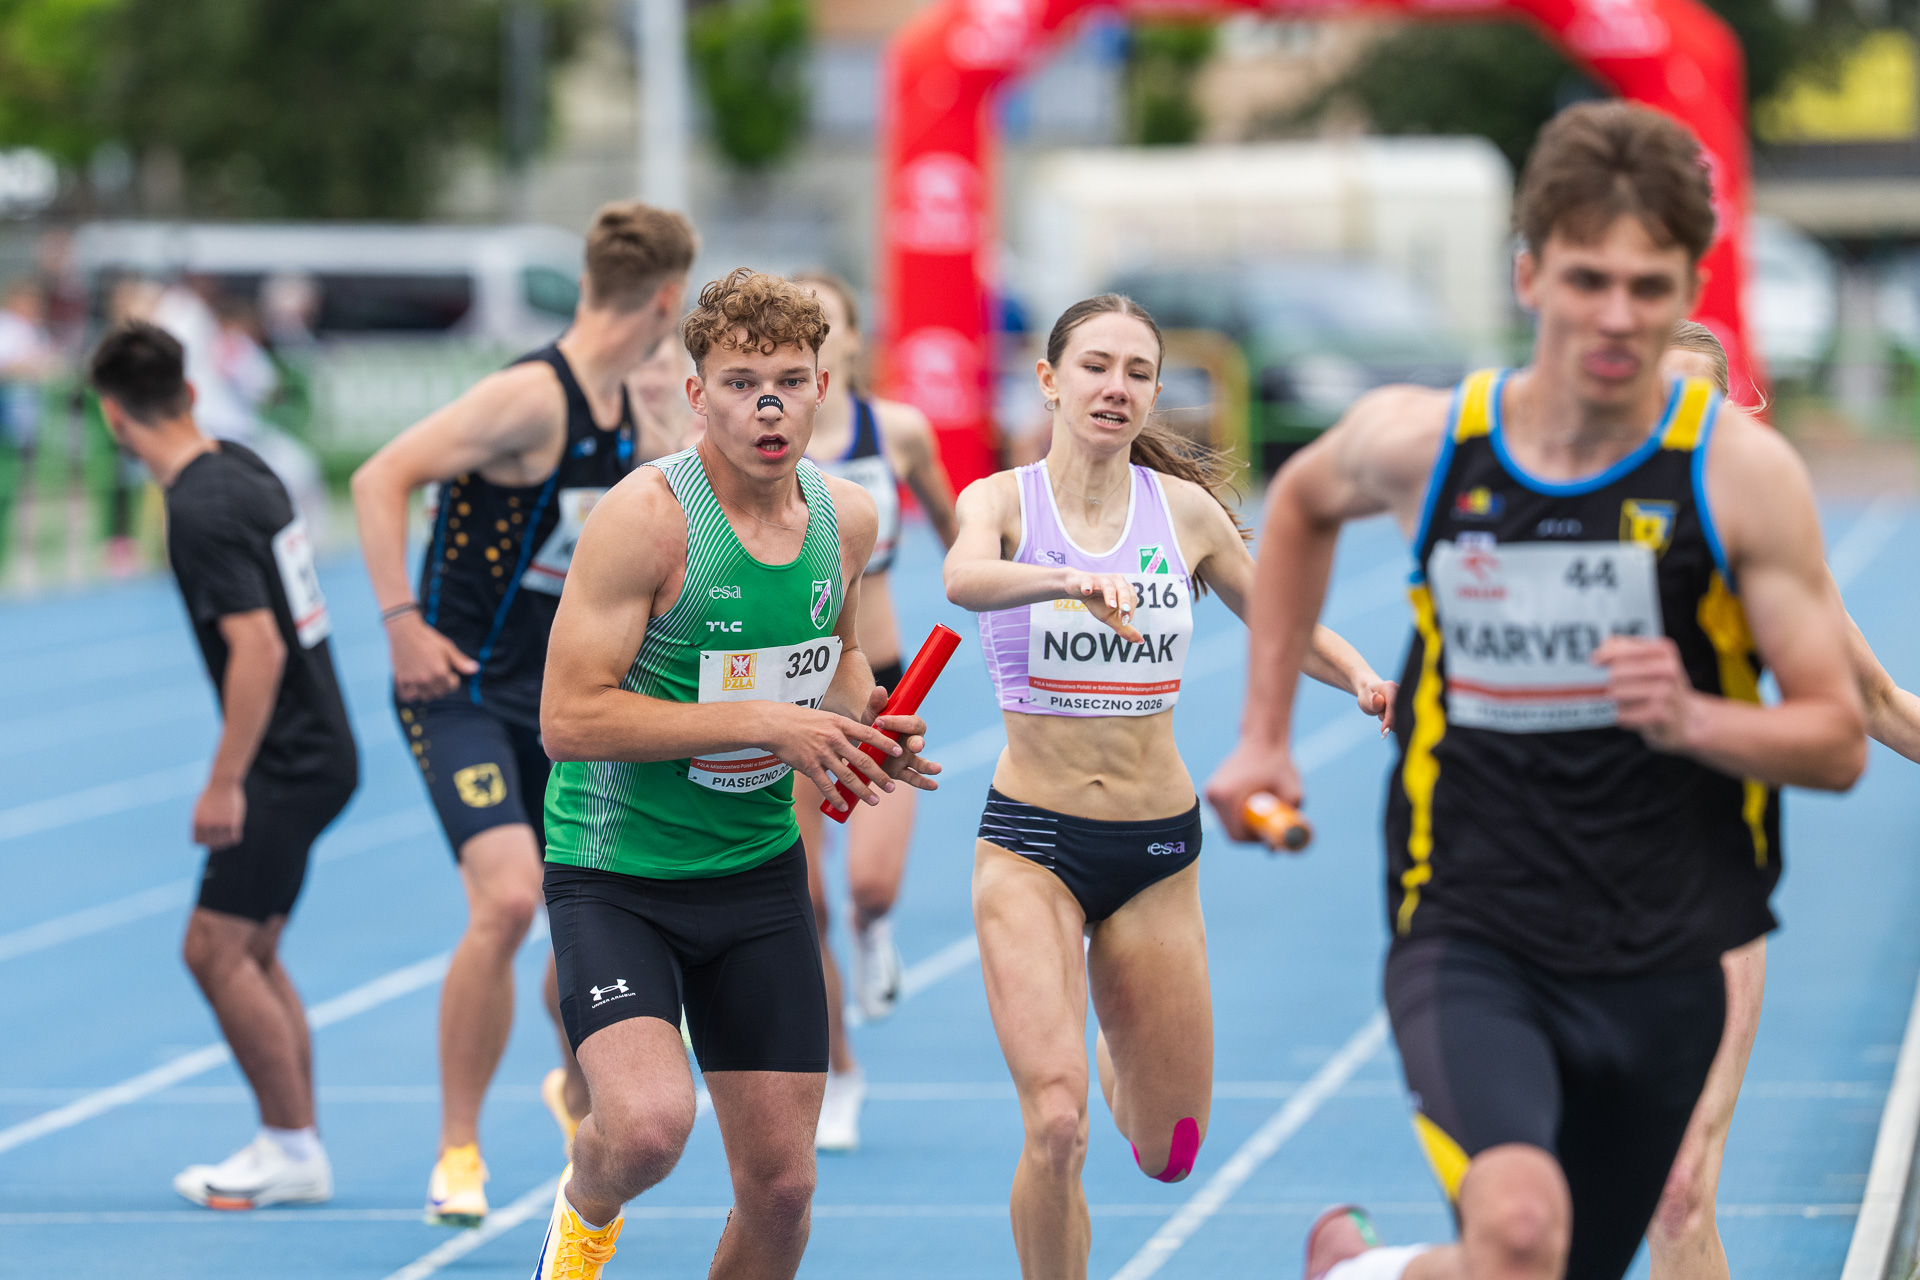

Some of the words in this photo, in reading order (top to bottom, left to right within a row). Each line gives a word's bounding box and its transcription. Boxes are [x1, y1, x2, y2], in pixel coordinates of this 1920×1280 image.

[1035, 549, 1067, 565] esa
[1566, 556, 1619, 592] 44
[708, 585, 742, 599] esa
[705, 621, 743, 632] TLC
[1043, 631, 1179, 664] NOWAK
[785, 645, 830, 679] 320
[724, 678, 753, 689] PZLA
[1050, 696, 1133, 710] PIASECZNO
[1136, 699, 1163, 710] 2026
[712, 770, 778, 788] PIASECZNO
[1147, 841, 1185, 856] esa
